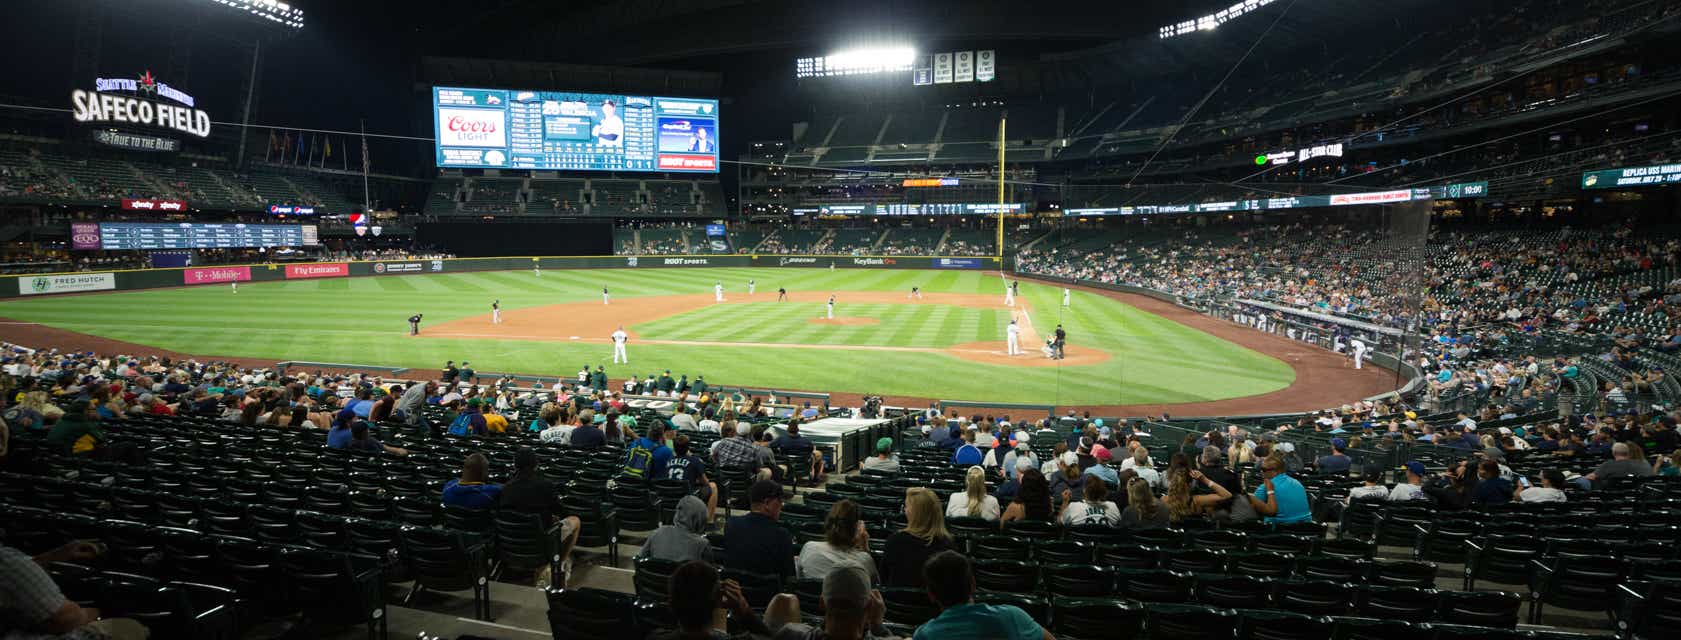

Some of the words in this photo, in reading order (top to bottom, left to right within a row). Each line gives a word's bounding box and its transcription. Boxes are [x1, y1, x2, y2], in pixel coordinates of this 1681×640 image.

[72, 89, 153, 124] SAFECO
[156, 103, 210, 137] FIELD
[448, 115, 496, 133] Coors
[110, 131, 130, 147] TRUE
[131, 137, 141, 147] TO
[141, 138, 155, 149] THE
[156, 138, 175, 151] BLUE
[457, 132, 488, 140] LIGHT
[1622, 167, 1647, 177] REPLICA
[1648, 166, 1660, 175] USS
[1464, 186, 1482, 194] 10:00
[132, 200, 154, 209] xfinity
[160, 202, 181, 210] xfinity
[294, 267, 308, 276] Fly
[308, 266, 340, 274] Emirates
